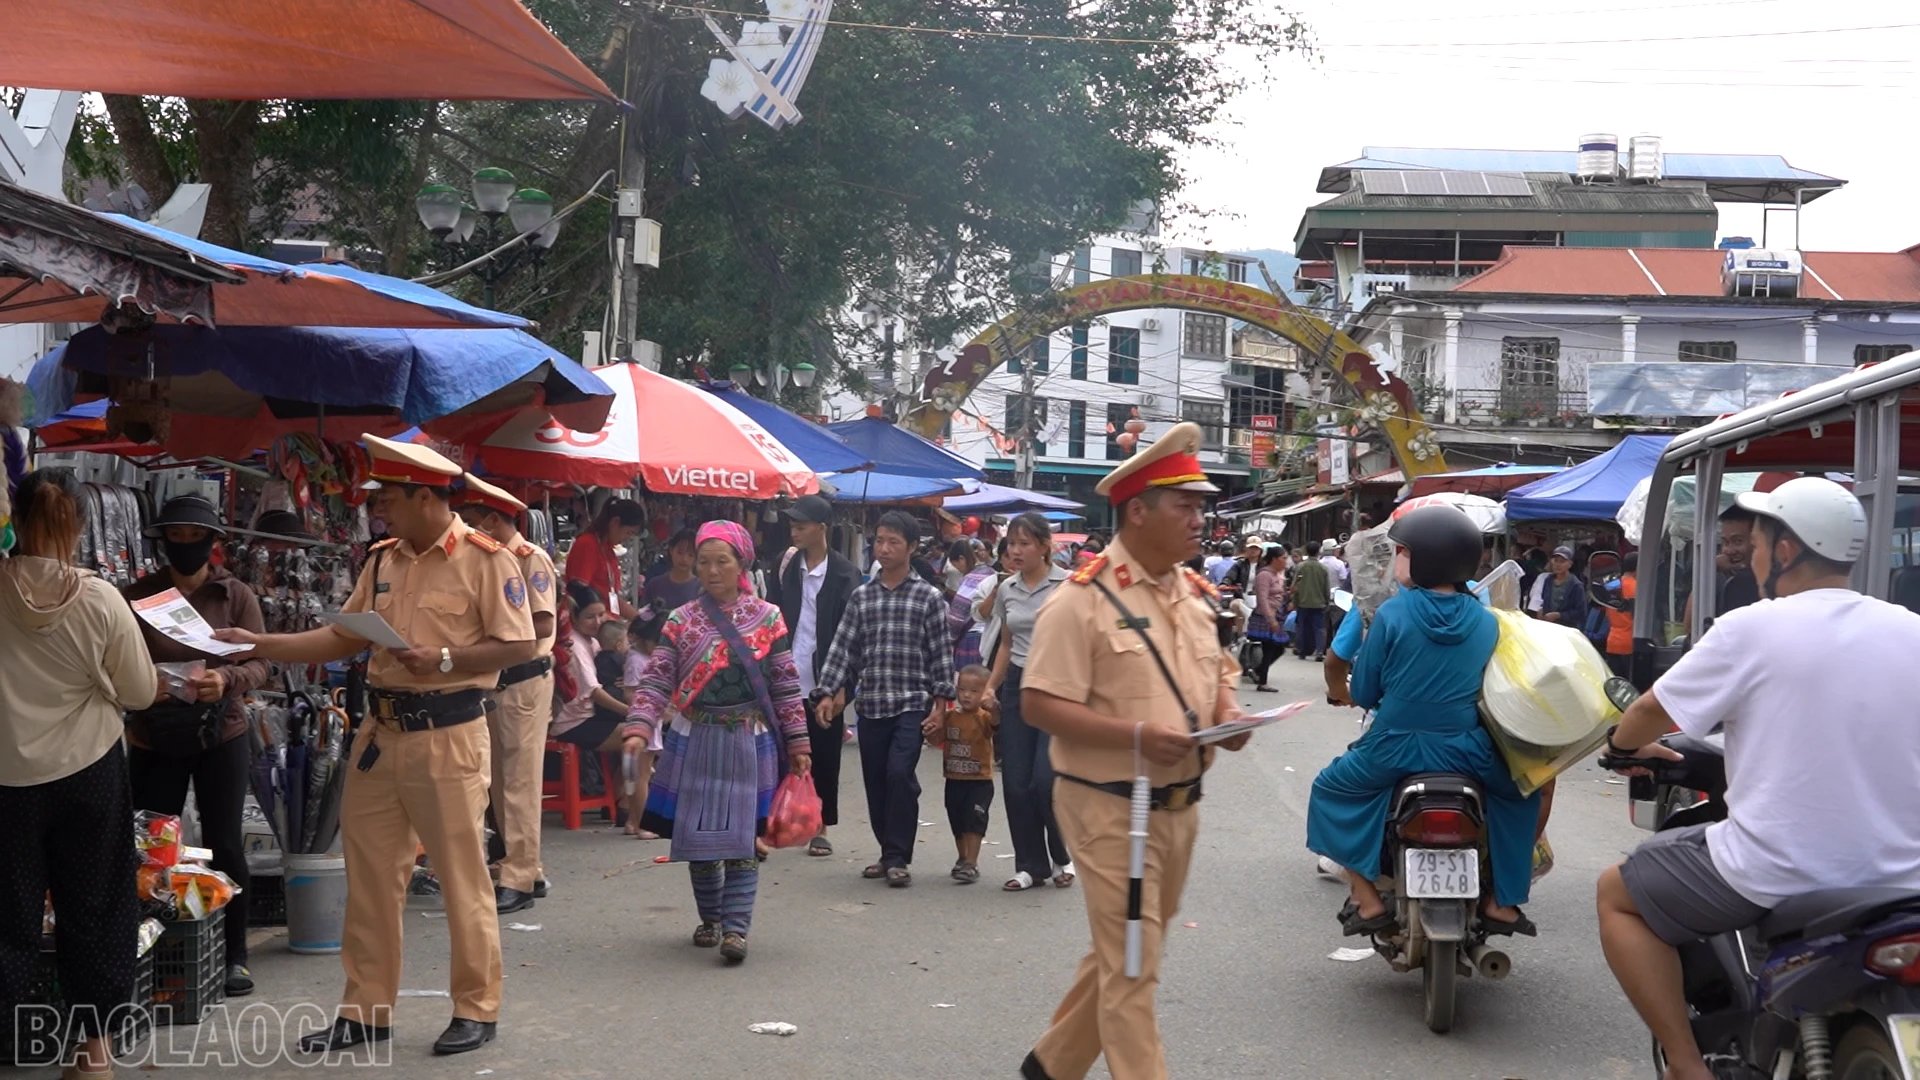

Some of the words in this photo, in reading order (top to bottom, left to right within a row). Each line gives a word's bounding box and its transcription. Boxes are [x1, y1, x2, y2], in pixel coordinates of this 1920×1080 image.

[662, 464, 759, 491] viettel
[1417, 852, 1467, 872] 29-S1
[1418, 874, 1468, 893] 2648
